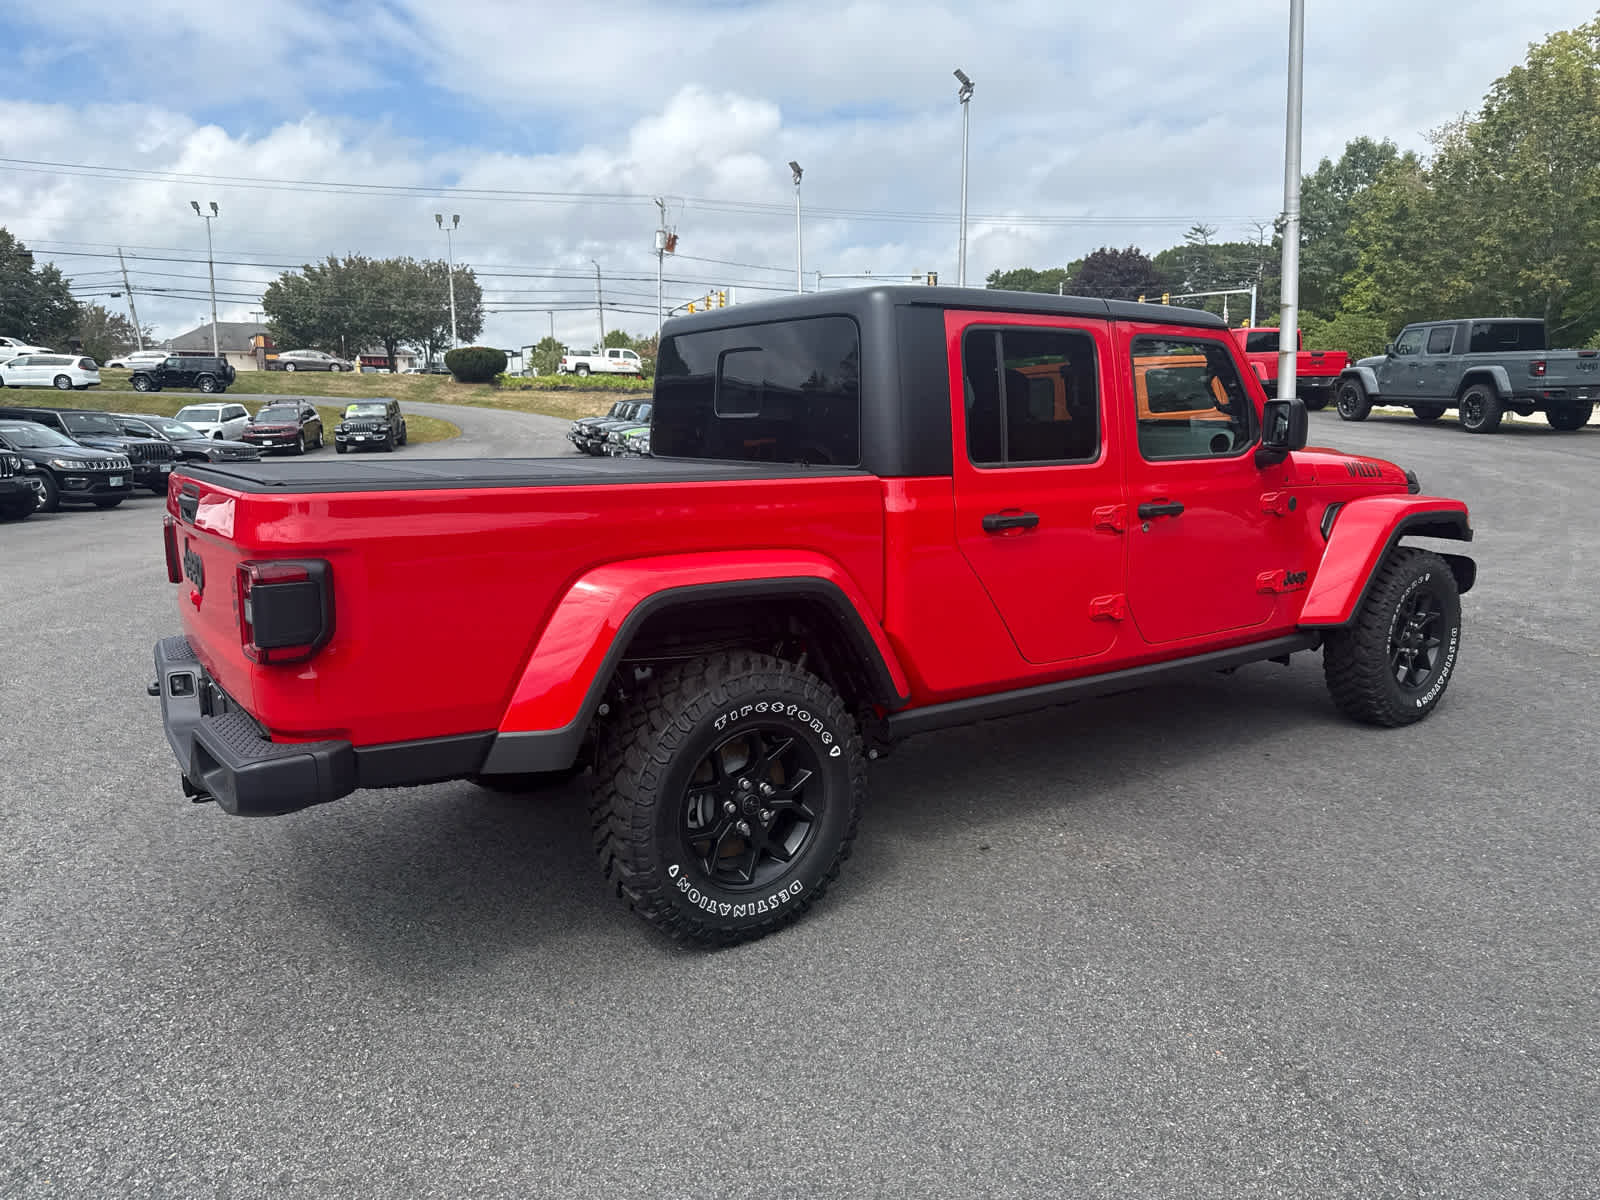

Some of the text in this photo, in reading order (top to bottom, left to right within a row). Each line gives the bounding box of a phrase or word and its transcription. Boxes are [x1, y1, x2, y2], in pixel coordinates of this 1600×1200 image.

[1283, 570, 1307, 587] Jeep
[714, 702, 834, 744] Firestone
[676, 879, 804, 918] DESTINATION
